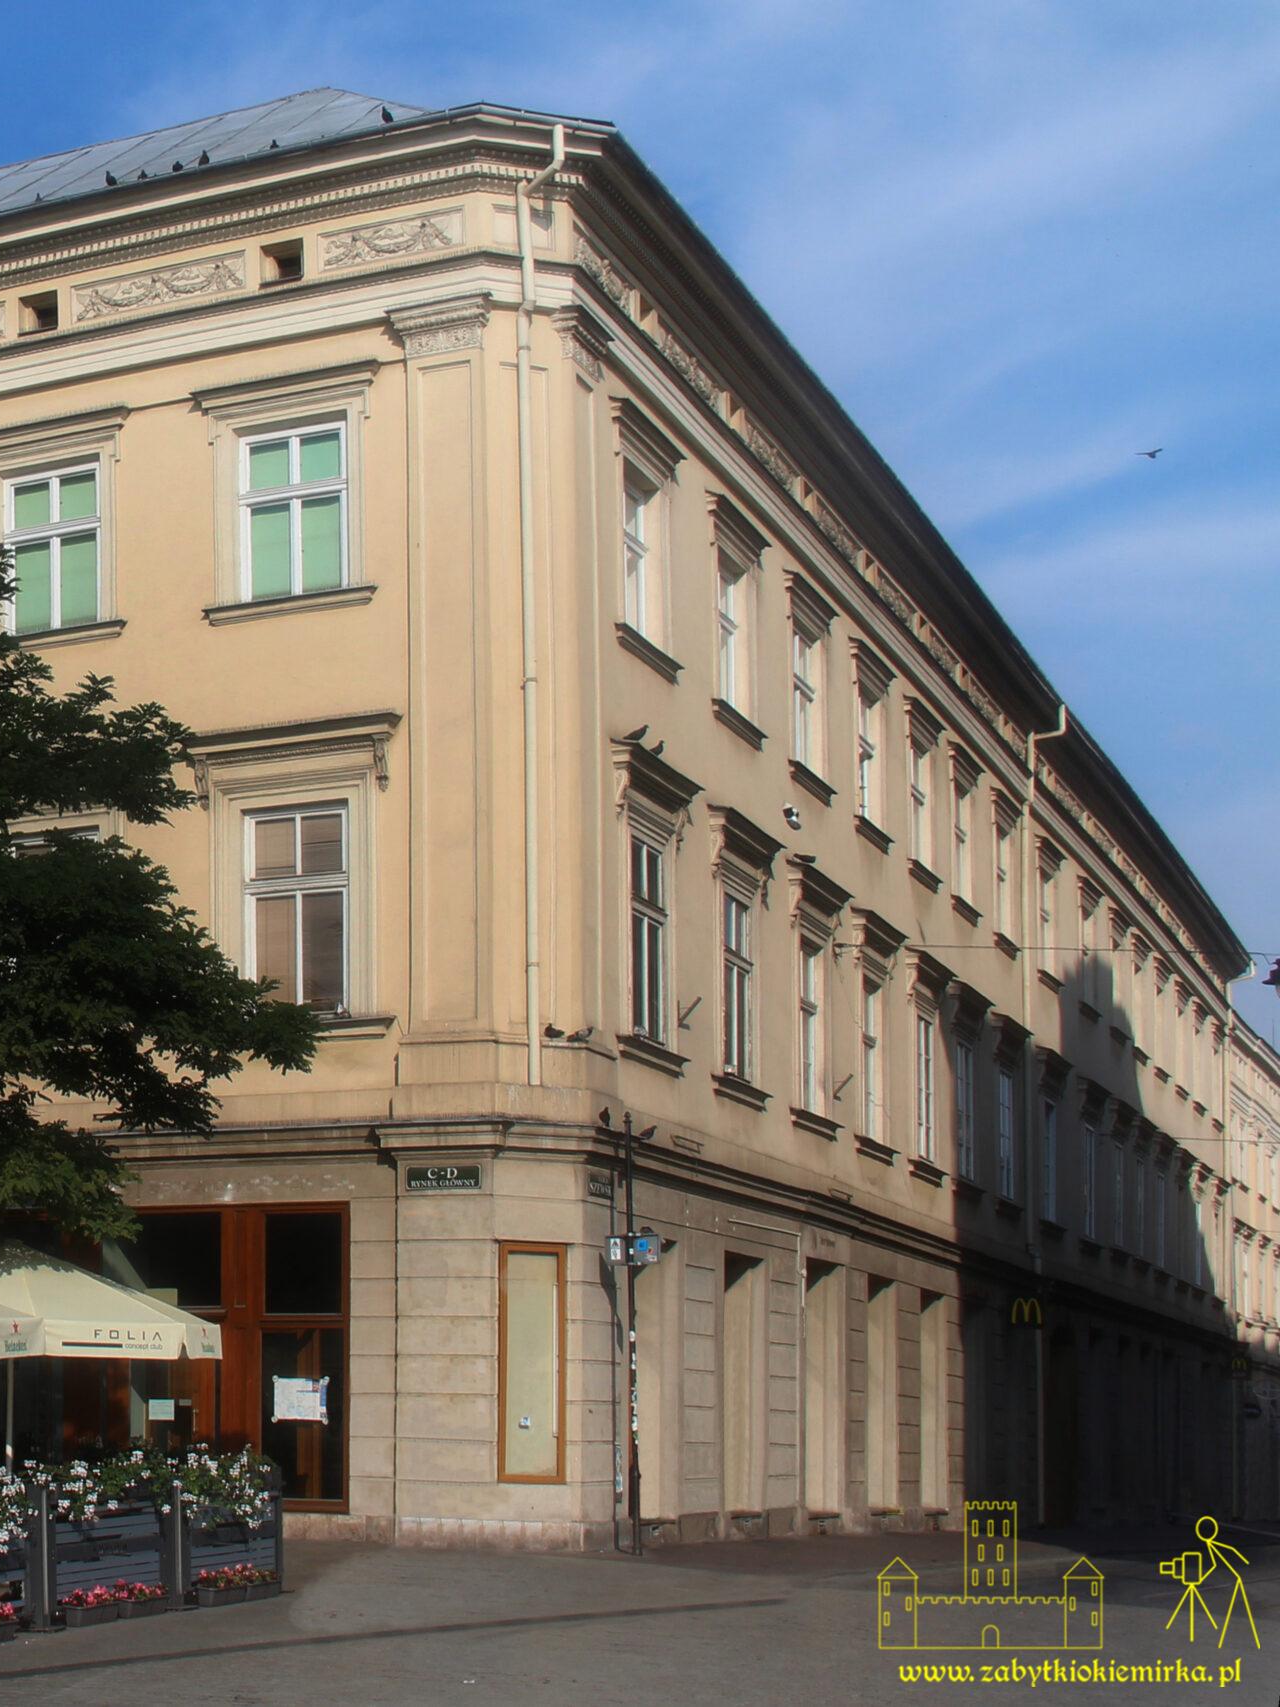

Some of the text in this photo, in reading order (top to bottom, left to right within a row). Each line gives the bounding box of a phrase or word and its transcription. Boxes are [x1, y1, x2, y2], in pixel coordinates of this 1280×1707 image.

[411, 1178, 475, 1188] RYNEK GŁÓWNY
[94, 1329, 162, 1341] FOLIA
[124, 1342, 163, 1351] concept club
